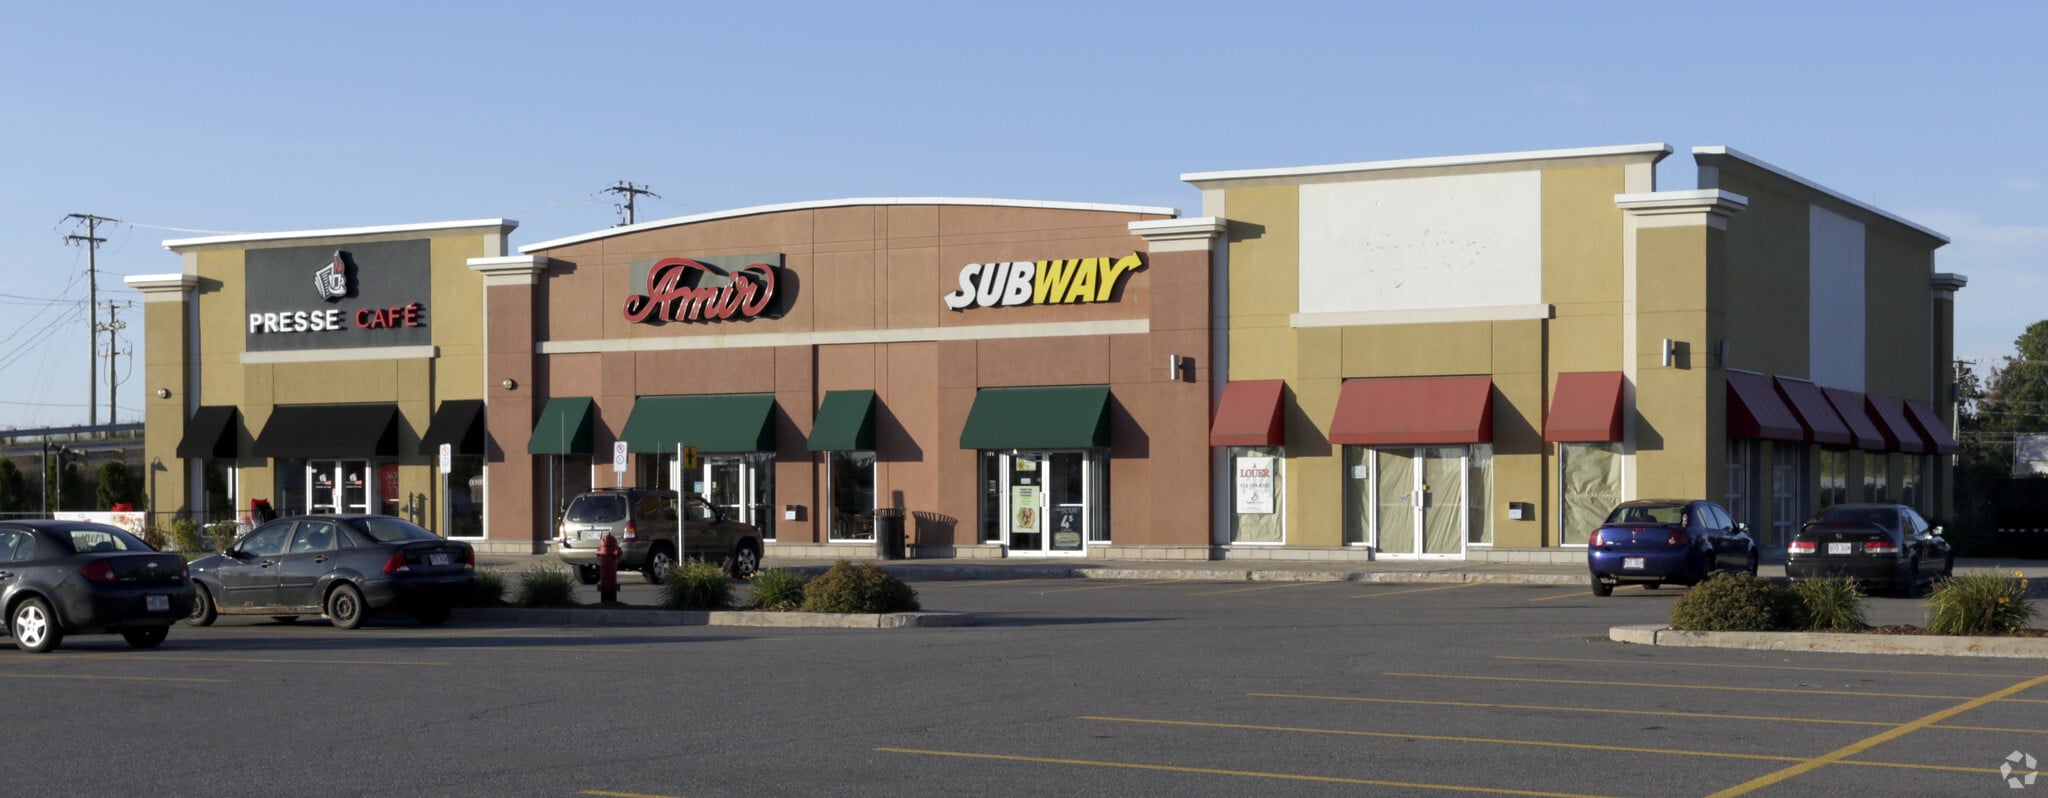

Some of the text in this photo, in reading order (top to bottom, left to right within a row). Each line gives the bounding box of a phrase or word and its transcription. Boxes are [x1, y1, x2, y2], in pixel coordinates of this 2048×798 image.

[623, 257, 775, 323] Amir
[944, 252, 1142, 310] SUBWAY
[249, 301, 418, 333] PRESSE CAFÉ
[1239, 469, 1271, 478] LOUER
